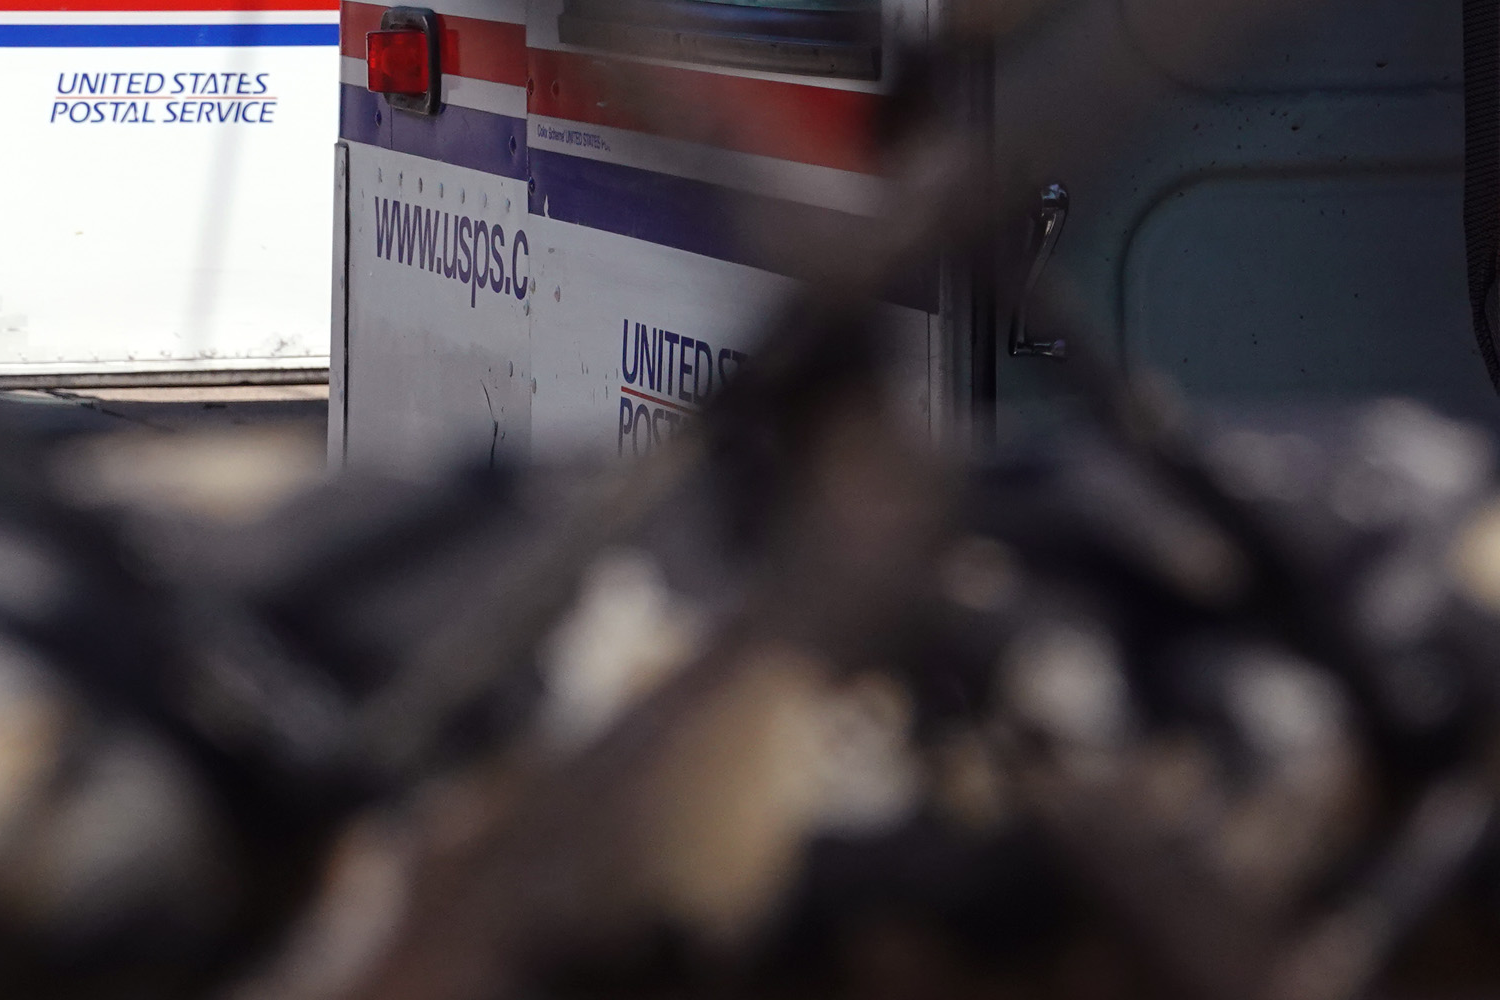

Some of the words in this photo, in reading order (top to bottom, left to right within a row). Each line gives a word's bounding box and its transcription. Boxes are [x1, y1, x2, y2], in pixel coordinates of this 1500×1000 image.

[57, 72, 165, 95] UNITED
[170, 72, 270, 95] STATES
[50, 101, 157, 124] POSTAL
[162, 101, 278, 124] SERVICE
[622, 319, 713, 405] UNITED
